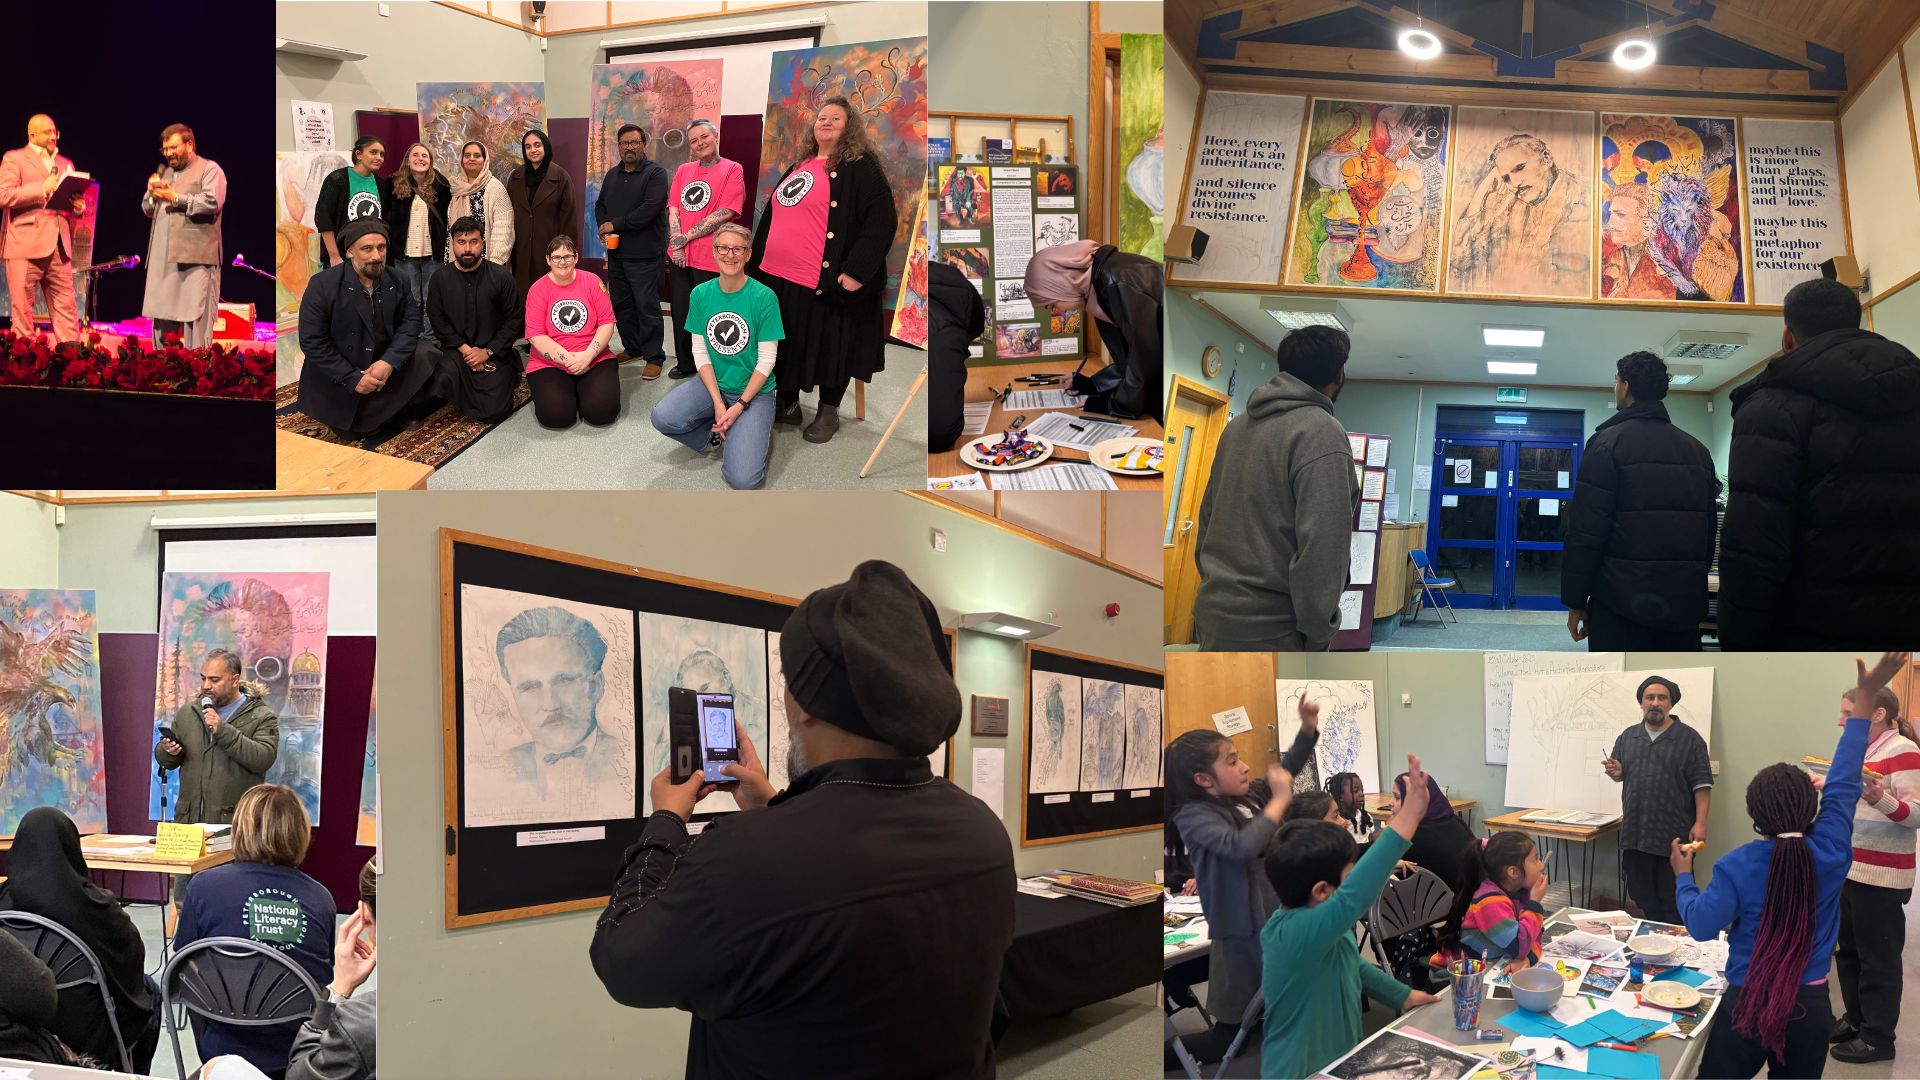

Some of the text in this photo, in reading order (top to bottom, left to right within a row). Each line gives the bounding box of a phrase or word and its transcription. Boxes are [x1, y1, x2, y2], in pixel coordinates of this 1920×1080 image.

[1204, 135, 1281, 151] Here, every
[1202, 147, 1286, 160] accent is an
[1749, 146, 1821, 157] maybe this
[1200, 156, 1285, 171] inheritance,
[1749, 155, 1799, 165] is more
[1750, 165, 1826, 178] than glass,
[1196, 178, 1277, 191] and silence
[1750, 176, 1829, 187] and shrubs,
[1194, 187, 1257, 200] becomes
[1751, 186, 1826, 198] and plants,
[1191, 198, 1236, 210] divine
[1752, 196, 1818, 207] and love.
[1189, 210, 1268, 222] resistance.
[1753, 217, 1828, 229] maybe this
[1754, 227, 1777, 237] is a
[1755, 239, 1822, 250] metaphor
[1755, 248, 1804, 259] for our
[708, 314, 747, 334] PETERBOROUGH
[711, 338, 746, 353] PRESENTS
[242, 888, 298, 925] PETERBOROUGH
[254, 904, 298, 915] National
[254, 913, 298, 928] Literacy
[254, 923, 284, 935] Trust
